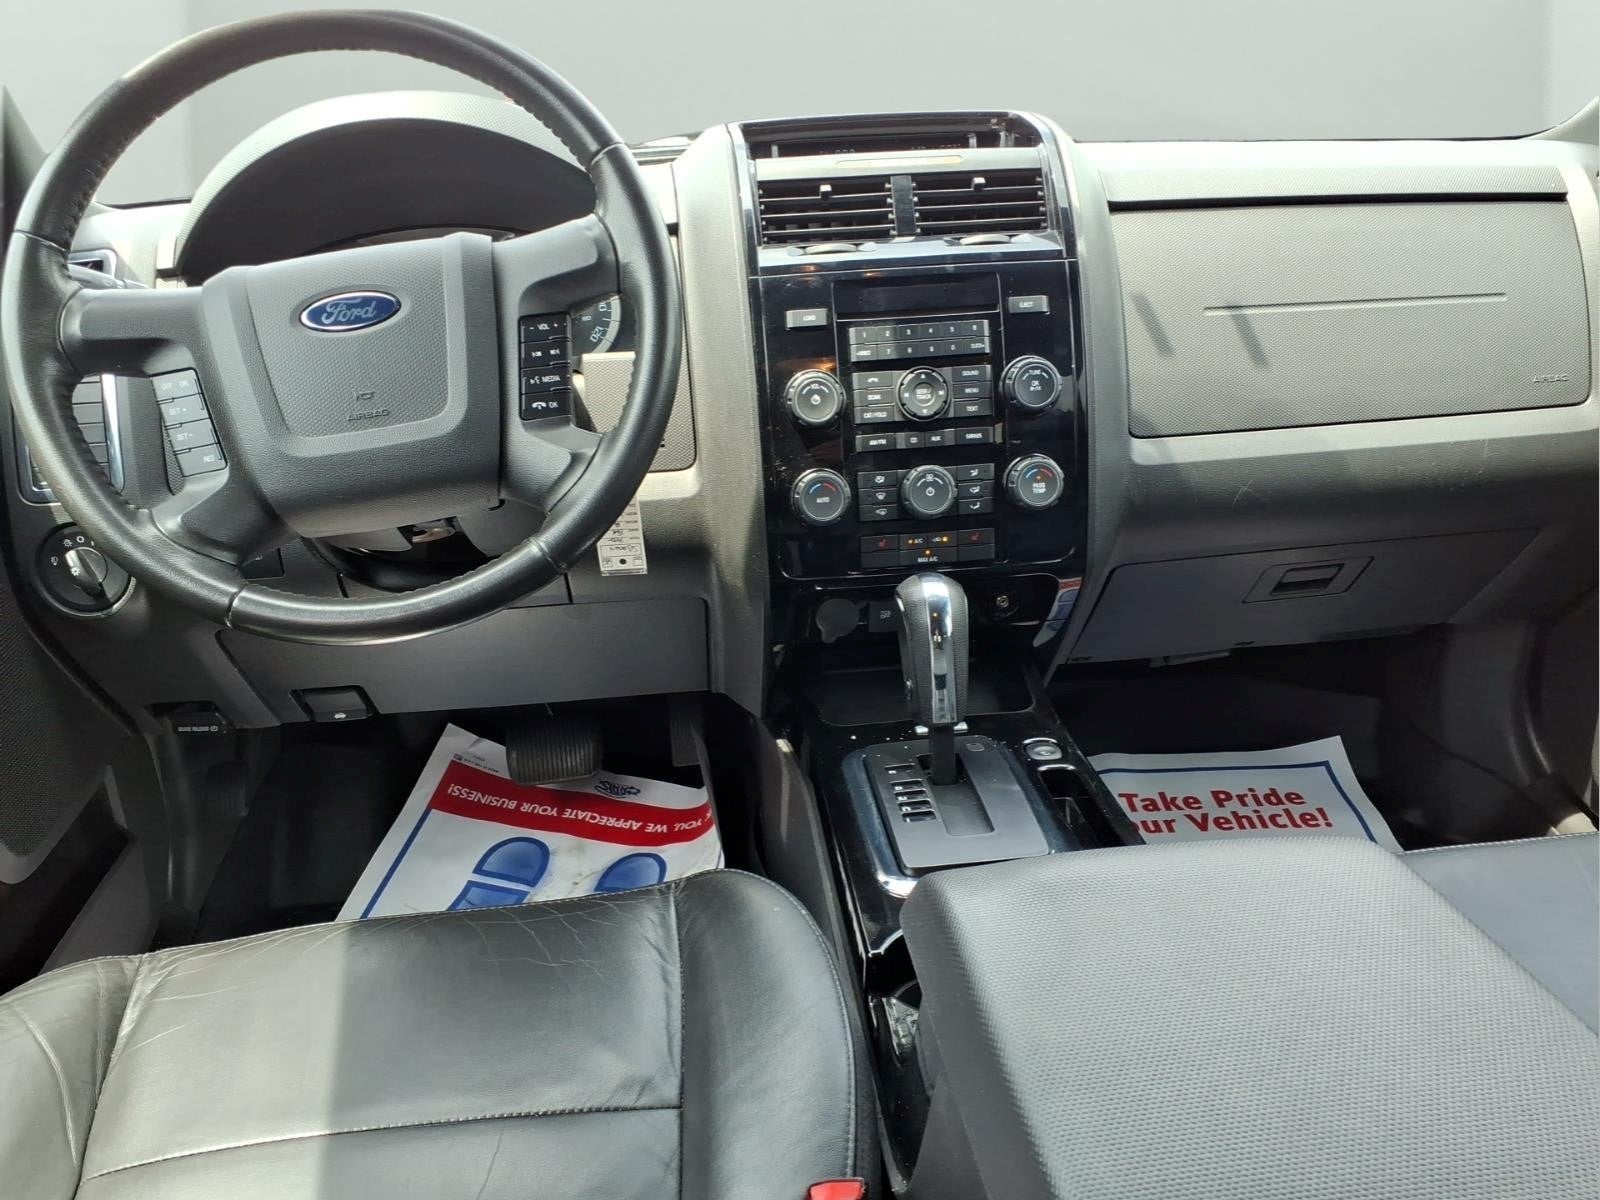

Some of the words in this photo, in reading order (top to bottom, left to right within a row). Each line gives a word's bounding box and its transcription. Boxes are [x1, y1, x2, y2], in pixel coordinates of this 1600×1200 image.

[321, 298, 377, 324] Ford
[541, 374, 561, 383] MEDIA
[548, 401, 559, 409] OK
[347, 409, 391, 421] AIRBAG
[447, 783, 518, 810] BUSINESS!
[1118, 791, 1203, 813] Take
[1210, 787, 1306, 808] Pride
[520, 801, 558, 817] YOUR
[562, 808, 643, 831] APPRECIATE
[644, 822, 668, 833] WE
[1184, 807, 1334, 832] Vehicle!
